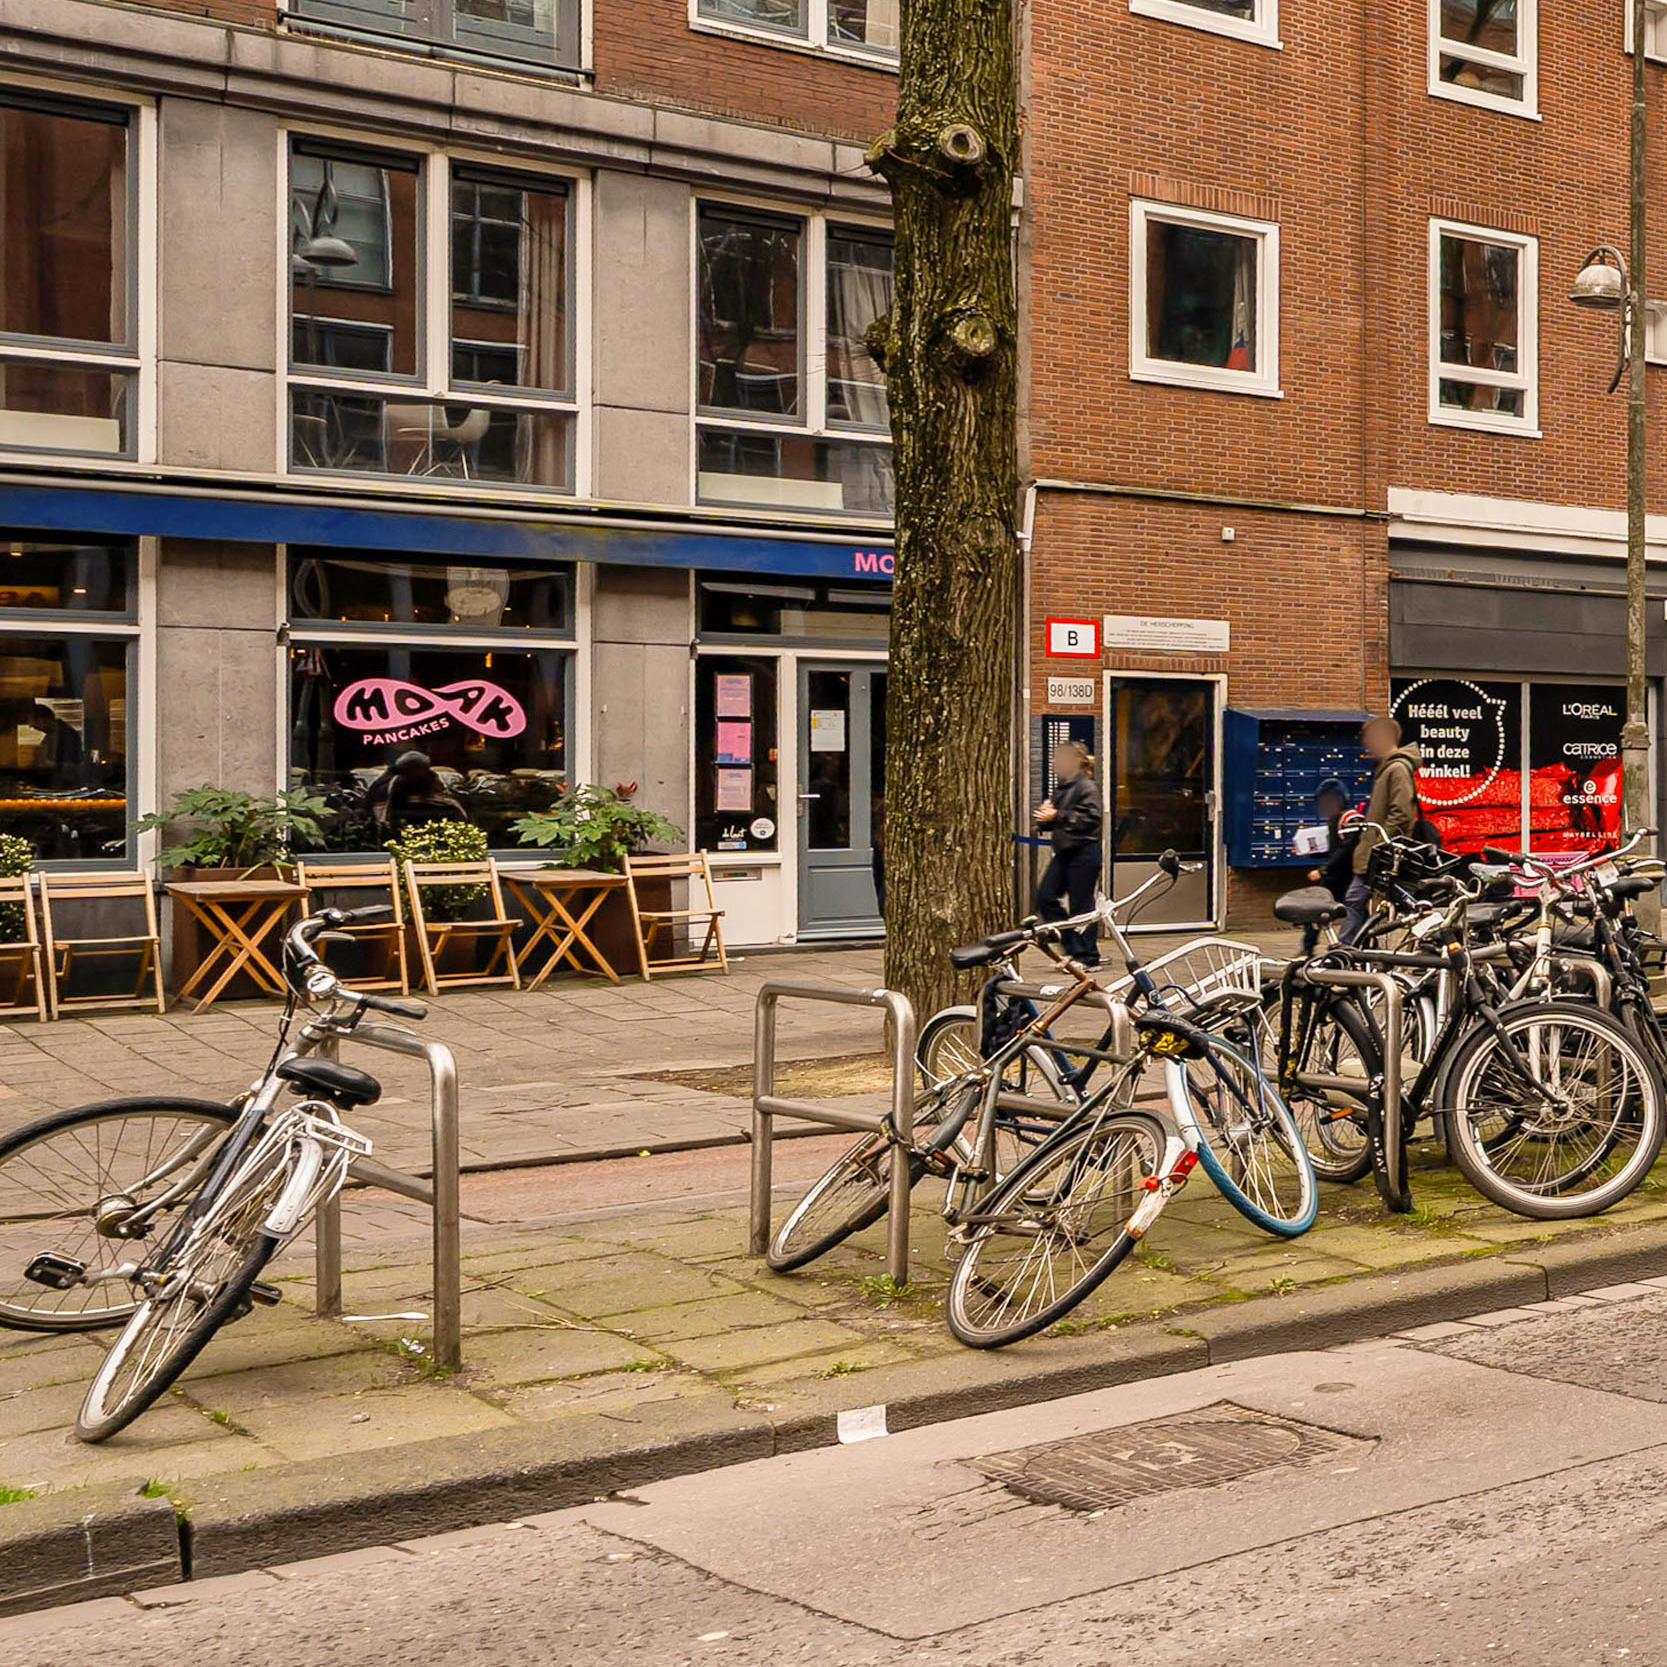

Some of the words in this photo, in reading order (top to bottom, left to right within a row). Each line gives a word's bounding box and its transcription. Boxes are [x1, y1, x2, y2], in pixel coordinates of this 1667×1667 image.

[1067, 630, 1078, 646] B
[1050, 684, 1093, 698] 98/138D
[346, 686, 514, 732] MOAK
[1452, 705, 1483, 720] veel
[363, 717, 450, 745] PANCAKES
[1420, 723, 1470, 743] beauty
[1420, 743, 1435, 759] in
[1436, 744, 1470, 759] deze
[1418, 763, 1471, 779] winkel!
[1563, 794, 1618, 804] essence
